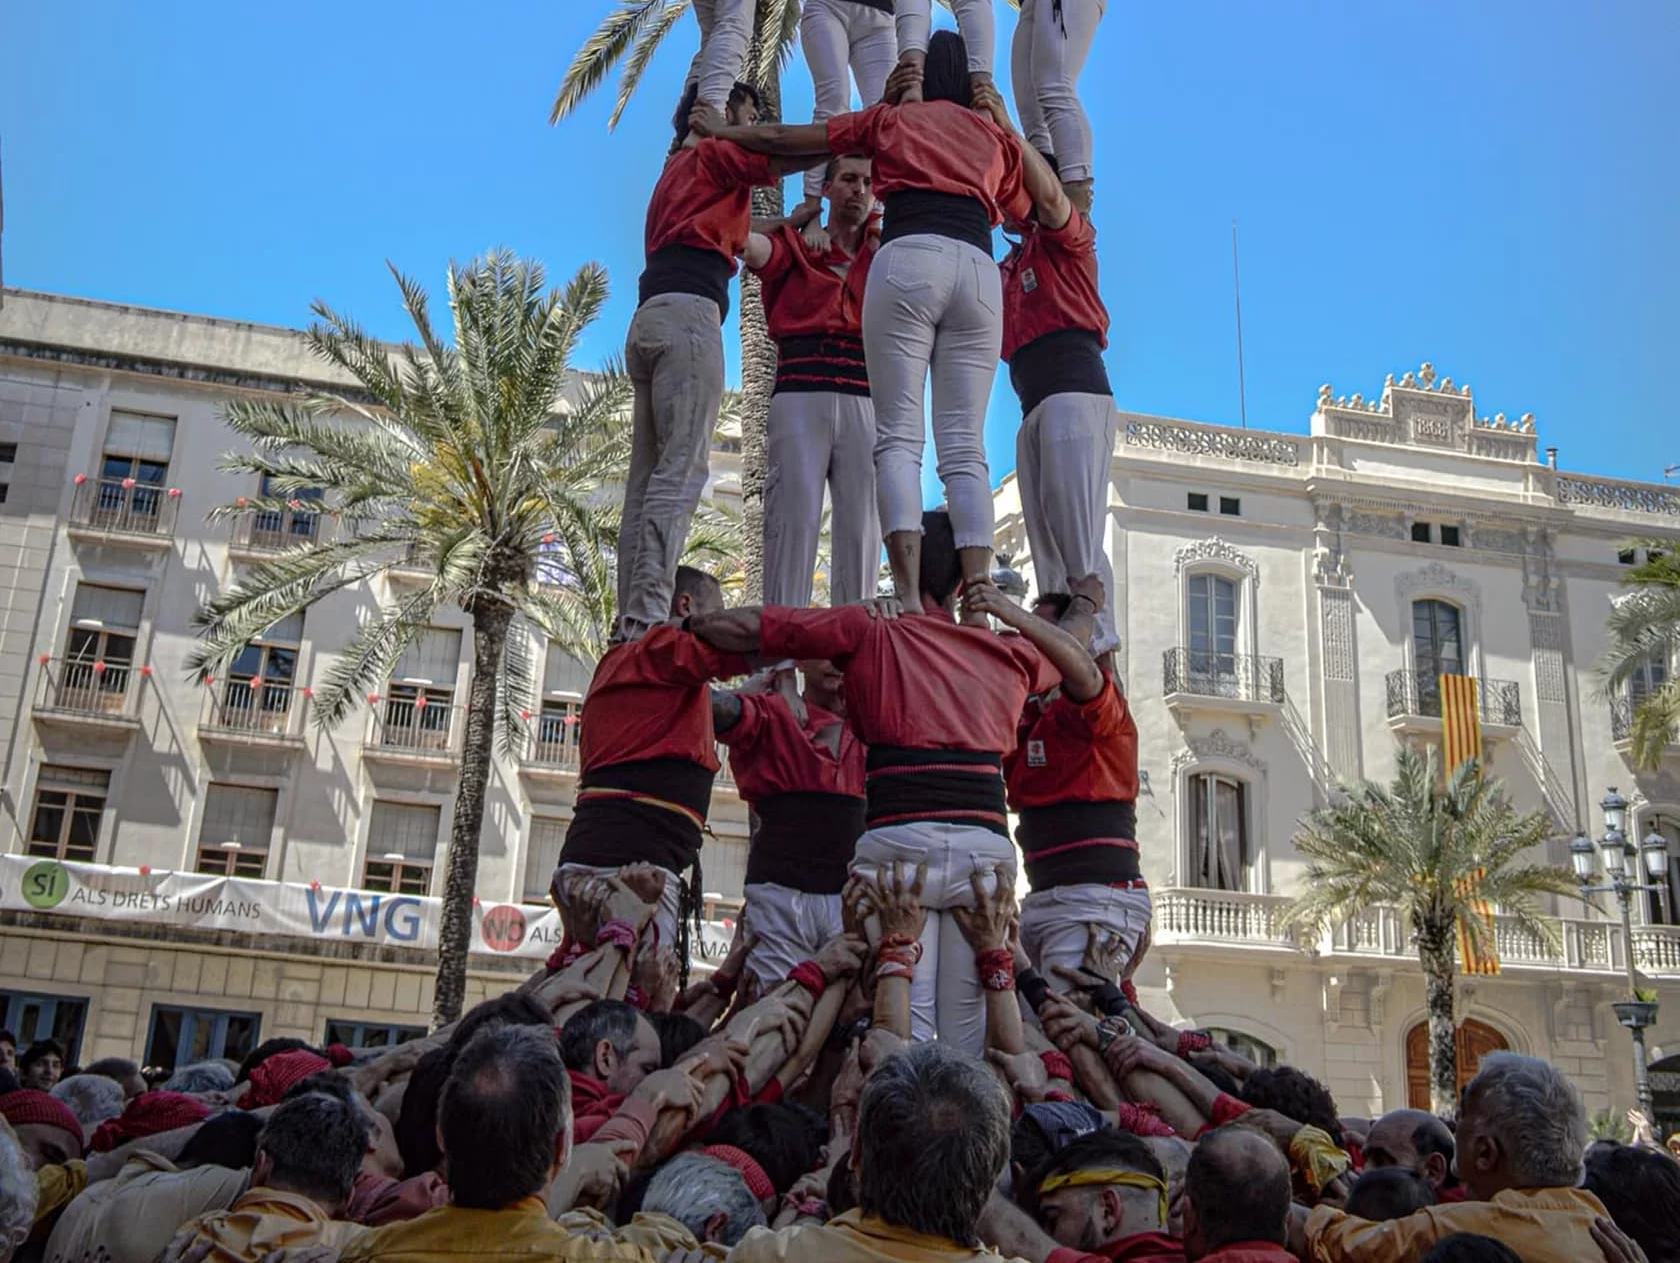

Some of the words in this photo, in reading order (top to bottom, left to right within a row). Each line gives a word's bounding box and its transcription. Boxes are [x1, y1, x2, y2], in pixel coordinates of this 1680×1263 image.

[32, 869, 58, 897] SÍ
[71, 888, 107, 905] ALS
[112, 890, 171, 911] DRETS
[176, 896, 261, 919] HUMANS
[305, 888, 422, 941] VNG
[486, 919, 524, 943] NO
[529, 926, 562, 944] ALS
[689, 940, 730, 957] RMA
